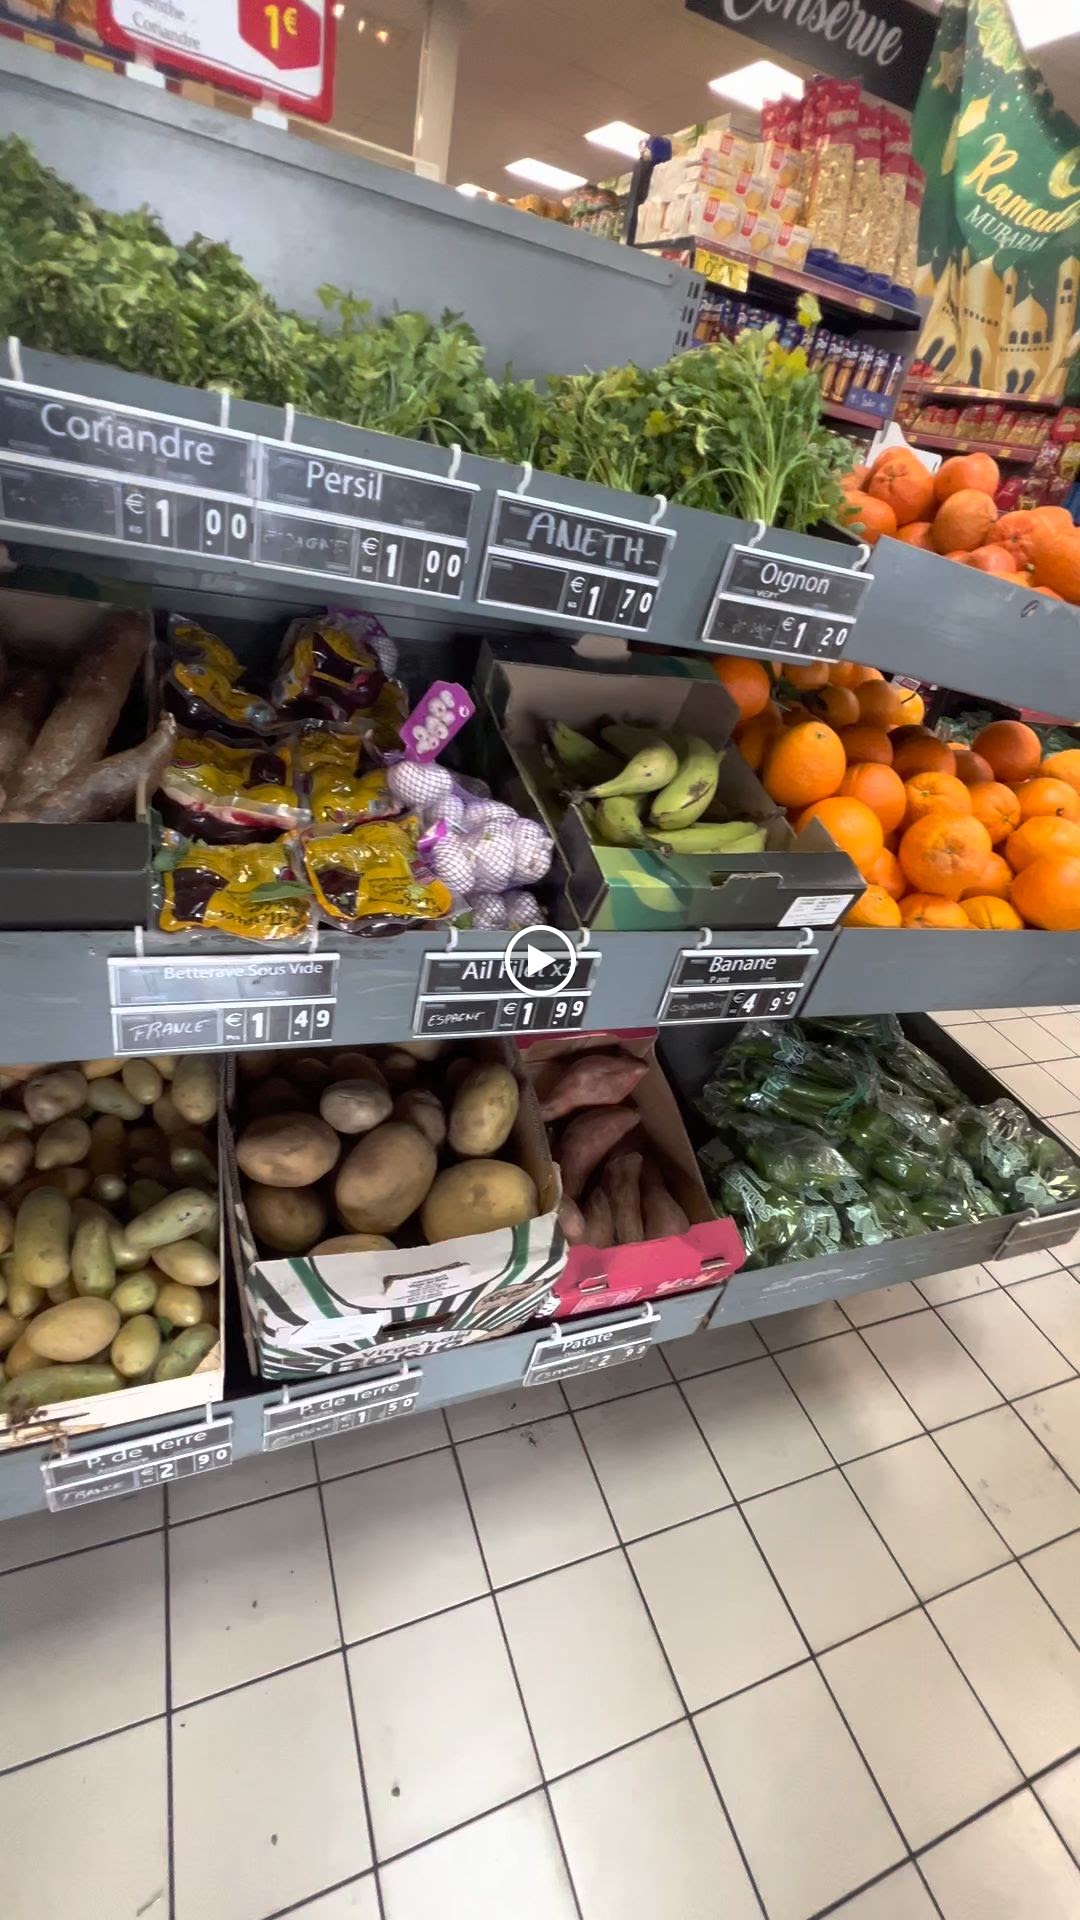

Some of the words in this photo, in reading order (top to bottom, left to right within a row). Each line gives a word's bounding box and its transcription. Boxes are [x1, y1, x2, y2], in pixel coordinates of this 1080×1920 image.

[964, 204, 1048, 252] MUBARA
[41, 403, 215, 465] Coriandre
[306, 460, 383, 501] Persil
[760, 562, 830, 595] Oignon
[163, 966, 244, 980] Betterave
[247, 965, 286, 977] Sous
[289, 962, 324, 975] Vide
[461, 960, 494, 980] Ail
[709, 957, 777, 973] Banane
[427, 1011, 486, 1027] ESPAGNE
[561, 1332, 614, 1352] Patate
[320, 1397, 346, 1410] de
[111, 1448, 143, 1463] de
